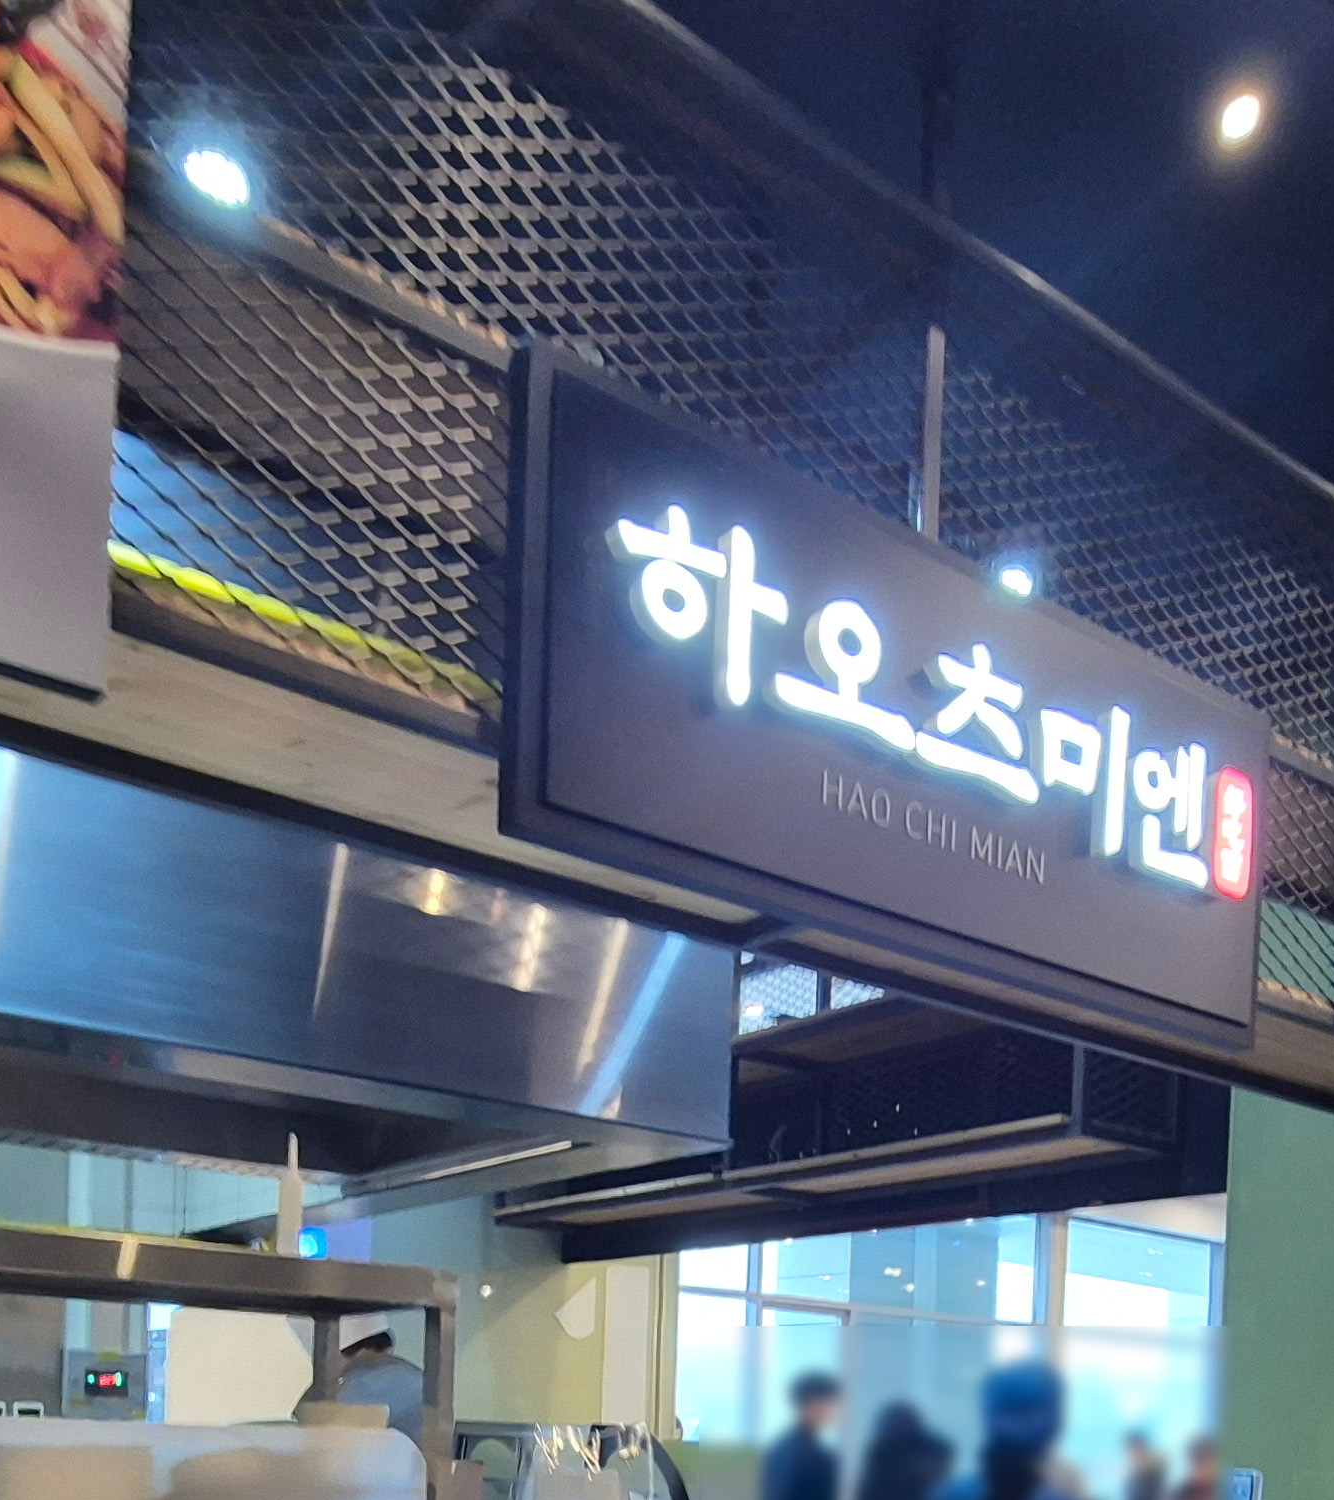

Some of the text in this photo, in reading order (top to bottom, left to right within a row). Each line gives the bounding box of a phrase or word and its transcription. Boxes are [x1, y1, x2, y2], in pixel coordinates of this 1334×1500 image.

[609, 503, 1210, 890] 하오츠미엔
[822, 769, 1045, 885] HAO CHI MIAN
